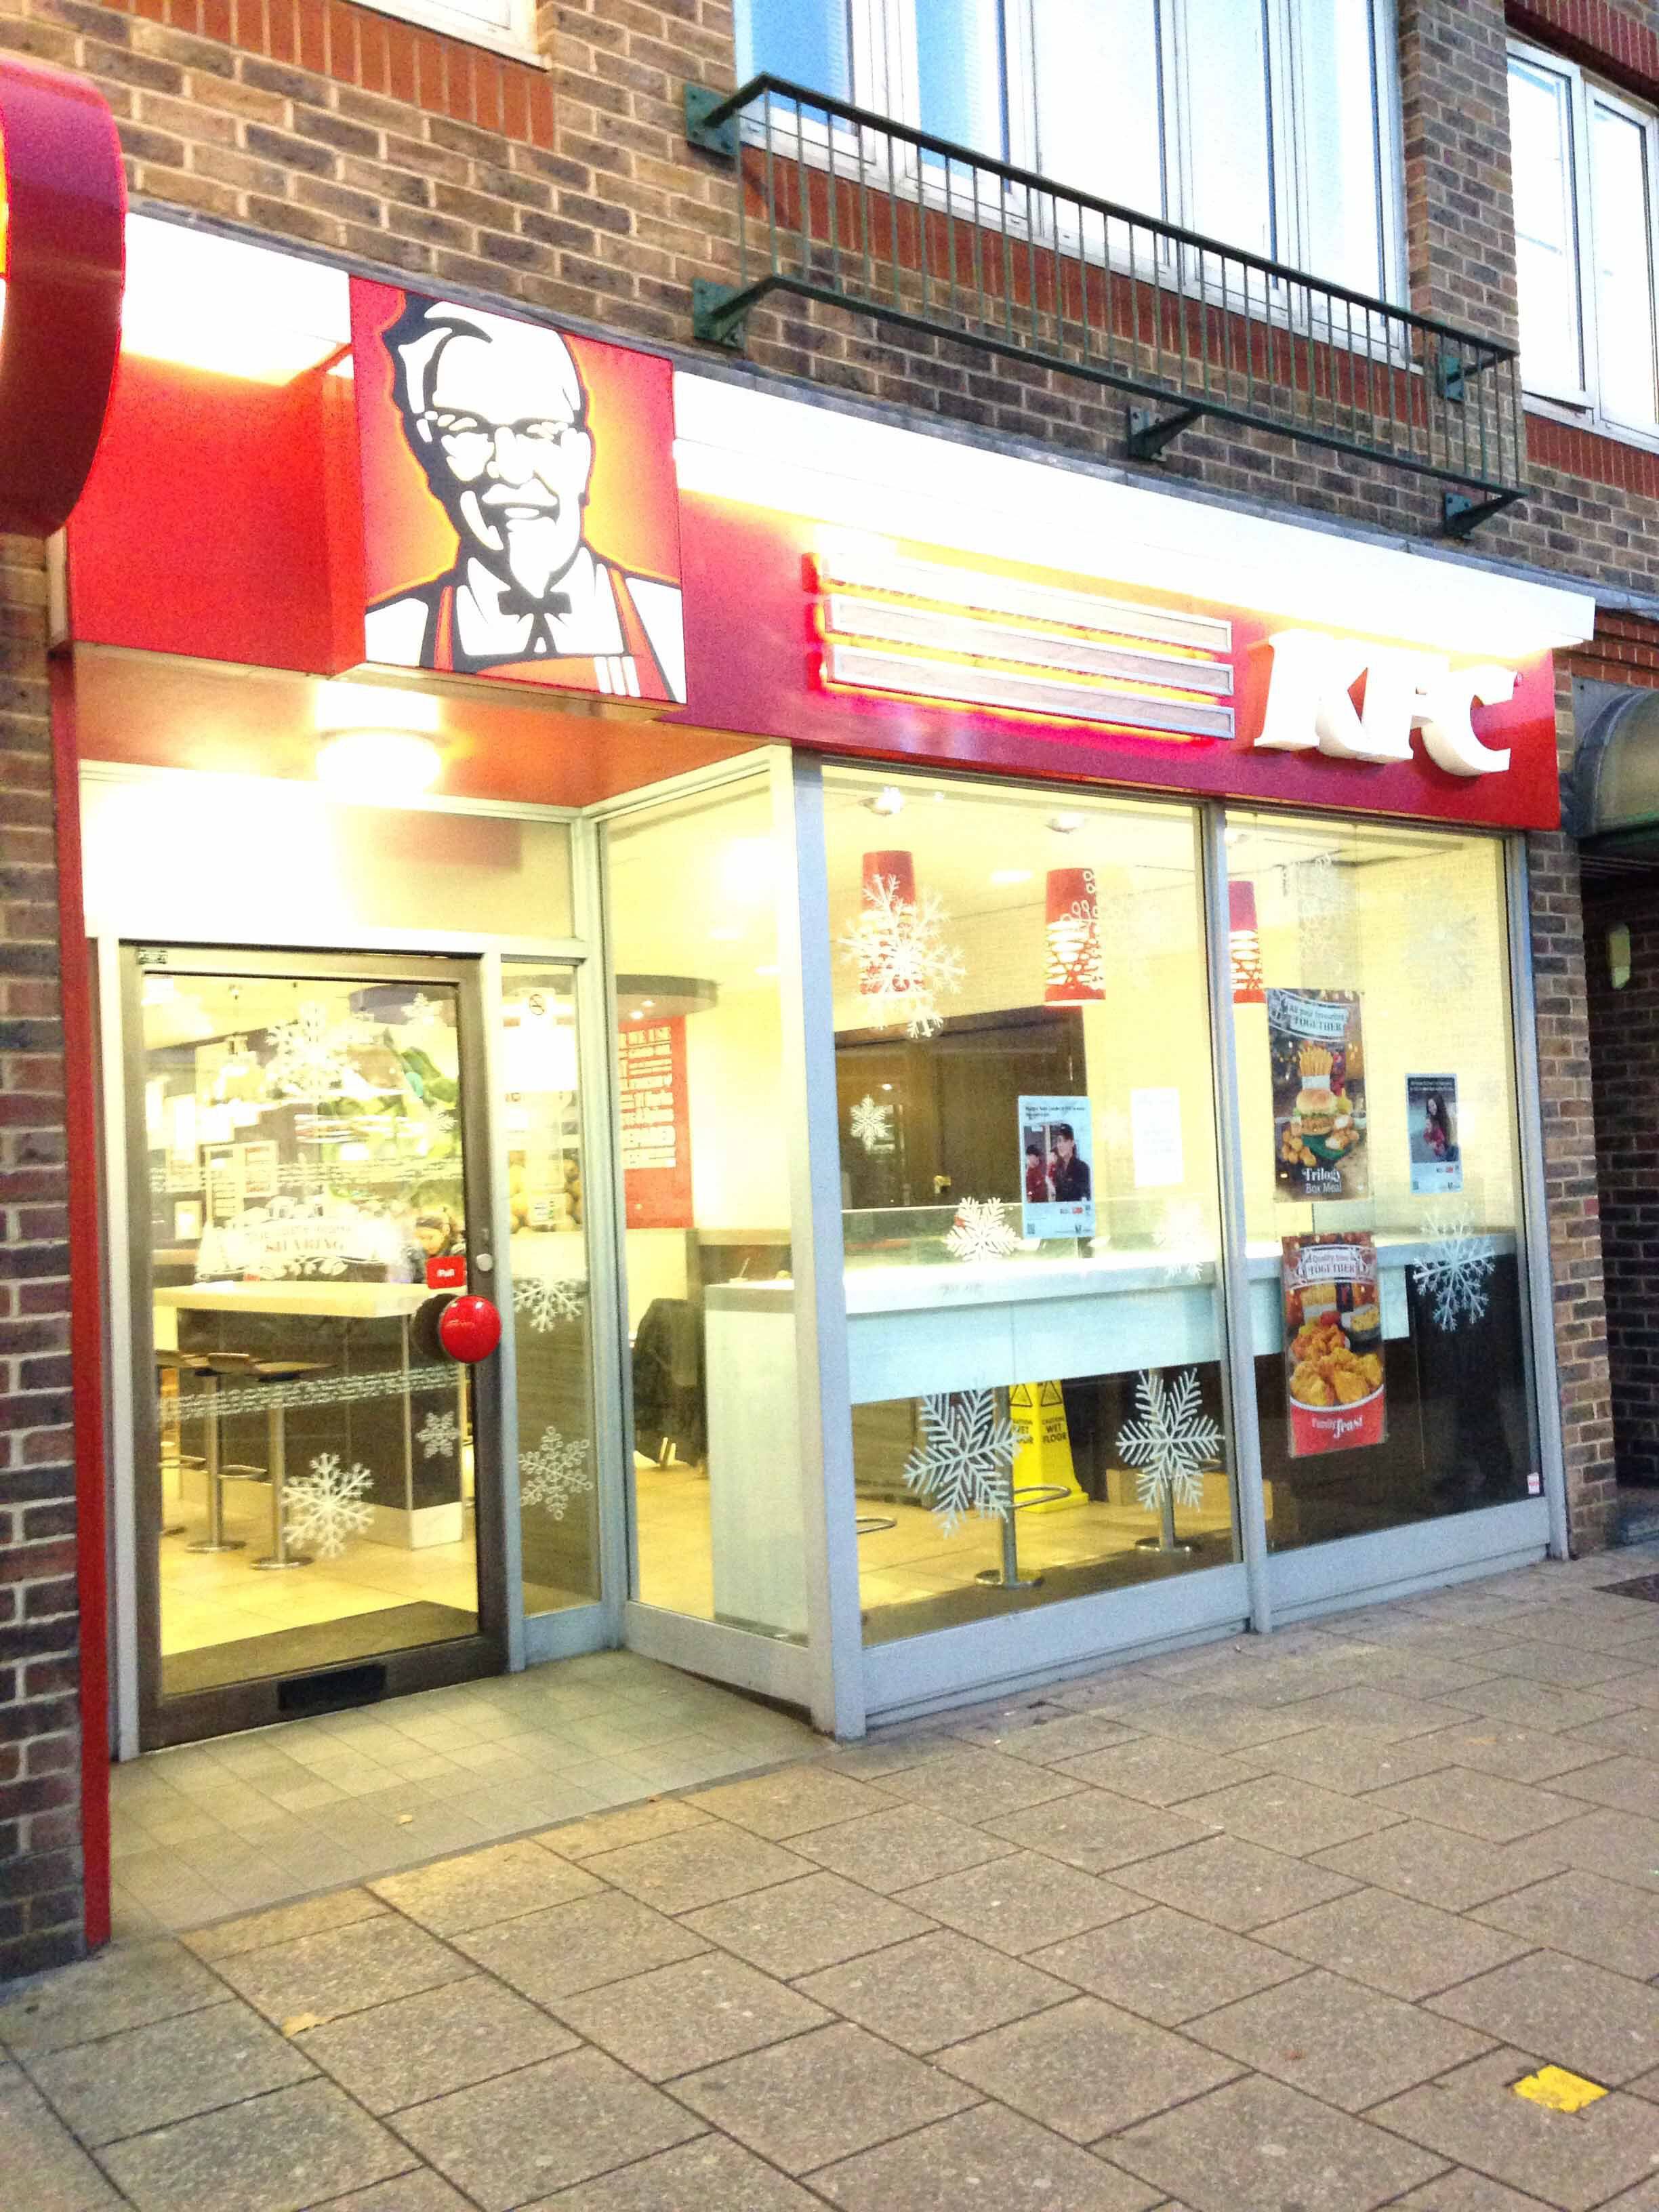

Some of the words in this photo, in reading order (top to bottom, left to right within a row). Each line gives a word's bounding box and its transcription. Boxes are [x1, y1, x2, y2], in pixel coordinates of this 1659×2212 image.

[1252, 629, 1518, 777] KFC
[1301, 1166, 1340, 1183] Trilogy
[1305, 1183, 1322, 1193] Box
[1322, 1182, 1341, 1193] Meal
[1046, 1423, 1062, 1433] WET
[1042, 1431, 1067, 1443] FLOOR
